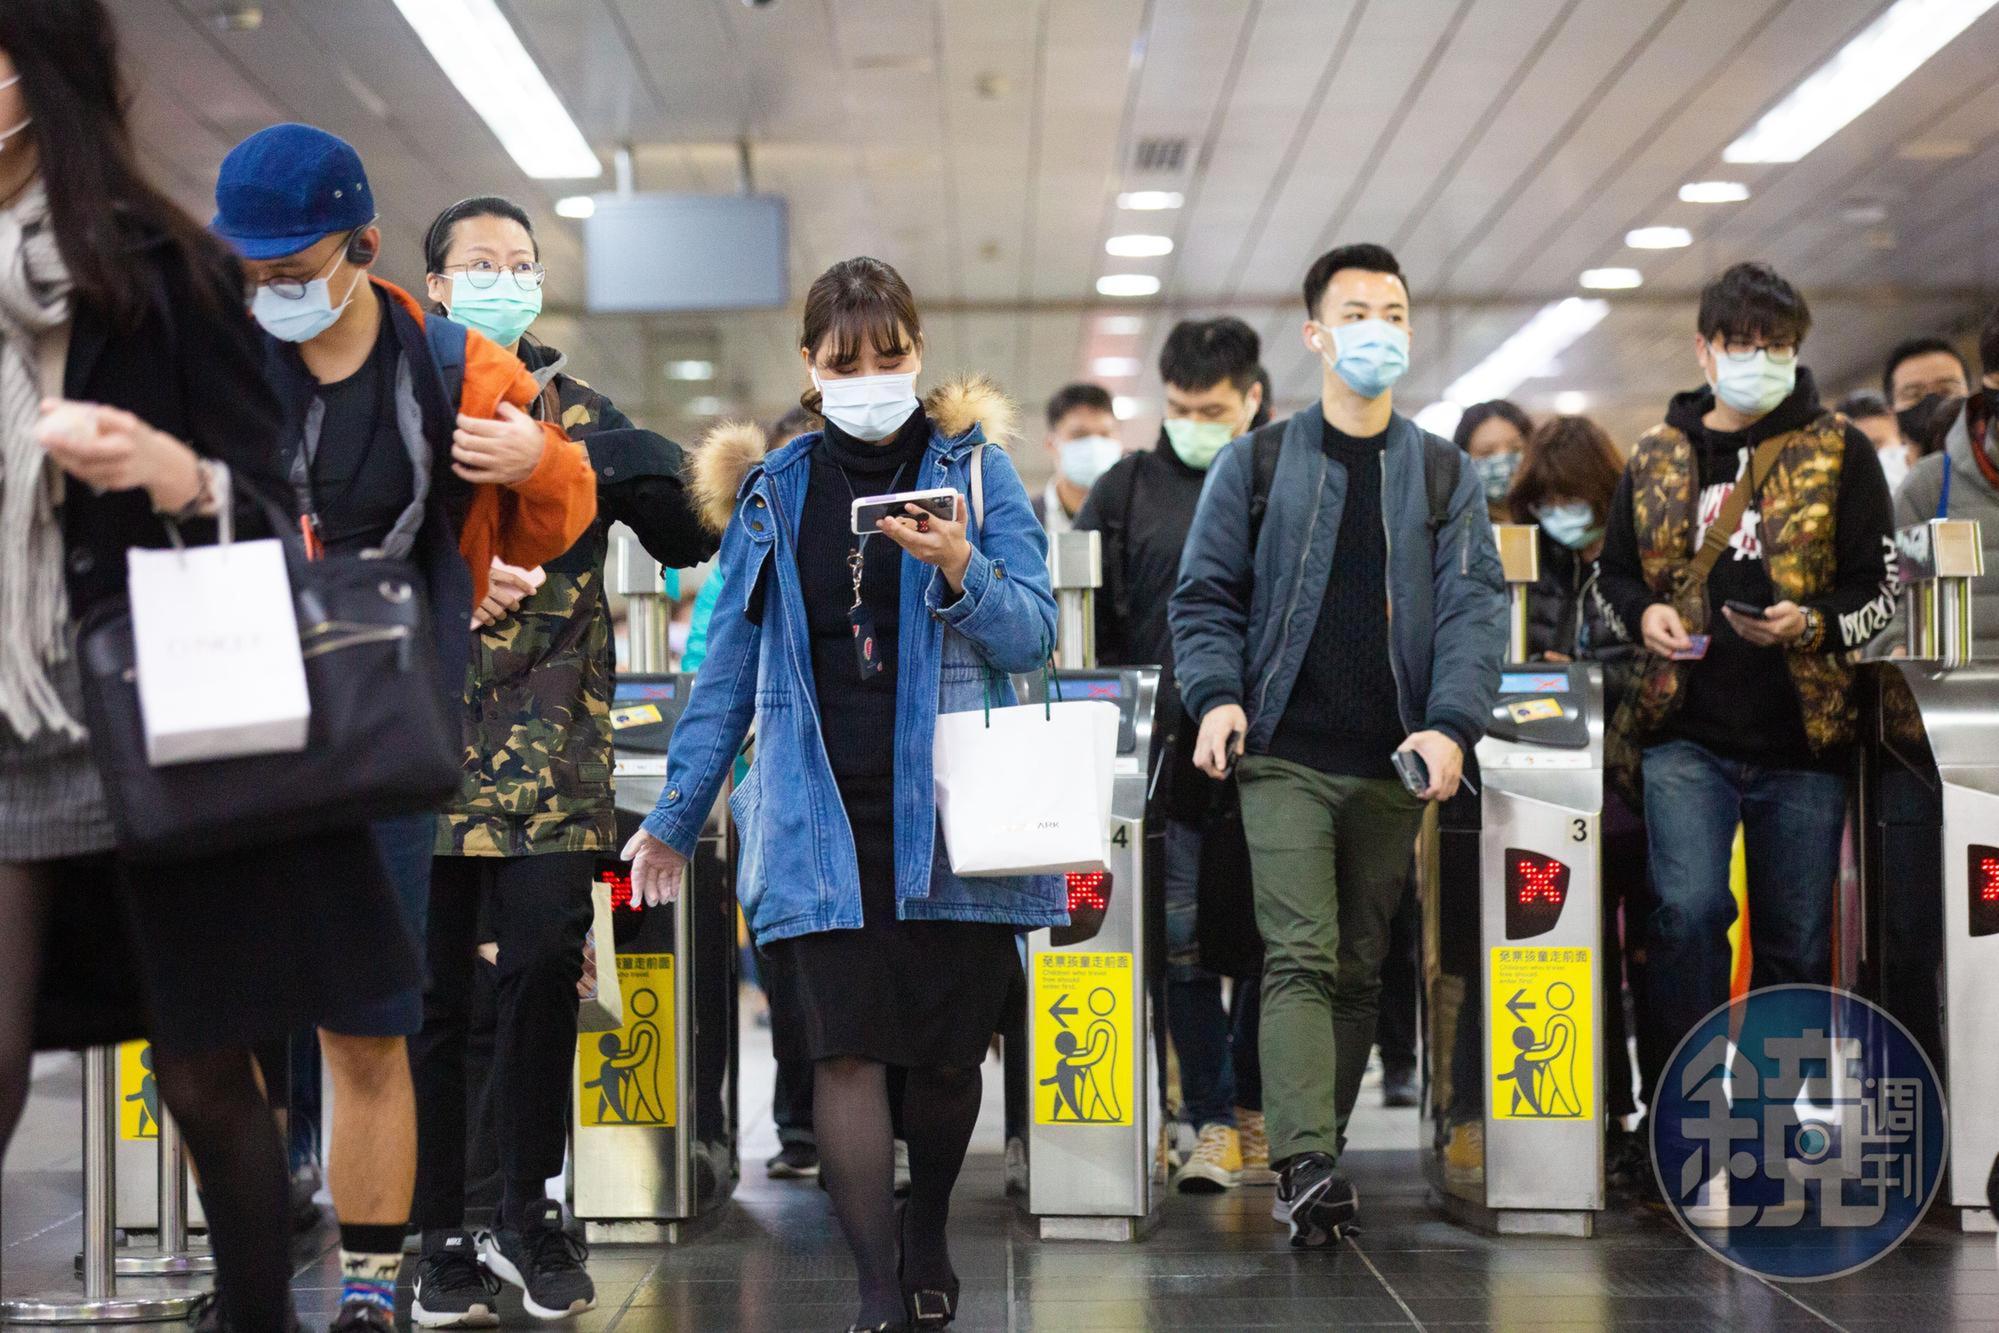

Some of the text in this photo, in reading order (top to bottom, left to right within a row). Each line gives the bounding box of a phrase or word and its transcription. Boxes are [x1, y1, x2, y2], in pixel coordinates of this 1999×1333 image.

[1112, 824, 1128, 848] 4
[1572, 818, 1588, 842] 3
[1042, 955, 1128, 968] 免票孩童走前面
